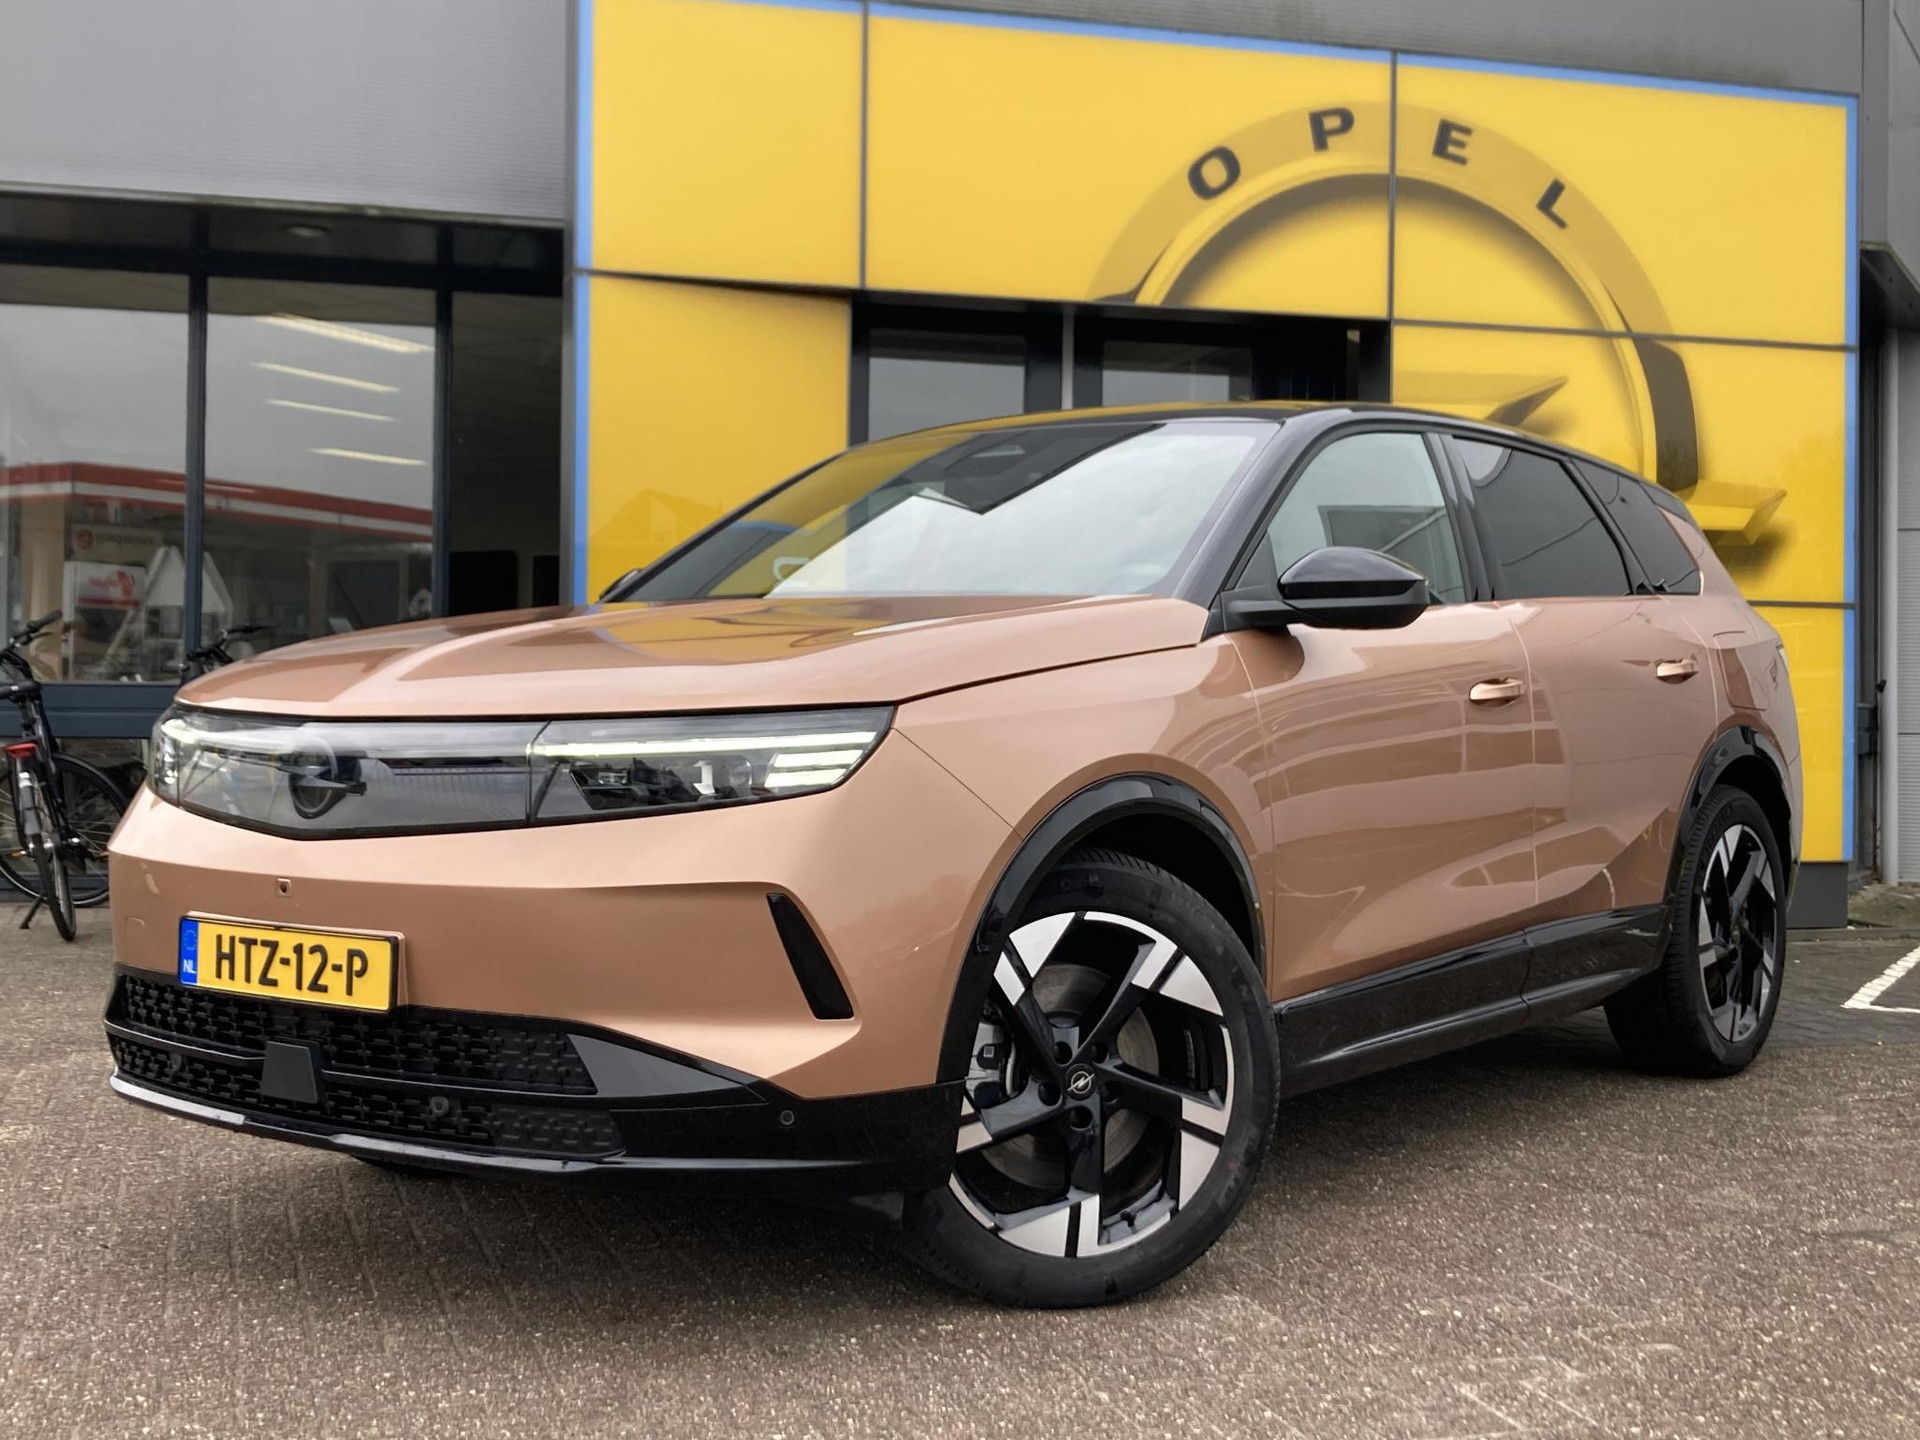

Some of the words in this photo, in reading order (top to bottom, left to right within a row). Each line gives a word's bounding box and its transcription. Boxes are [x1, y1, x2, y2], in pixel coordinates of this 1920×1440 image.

[1187, 107, 1568, 230] OPEL
[183, 958, 197, 974] NL
[215, 933, 369, 997] HTZ-12-P
